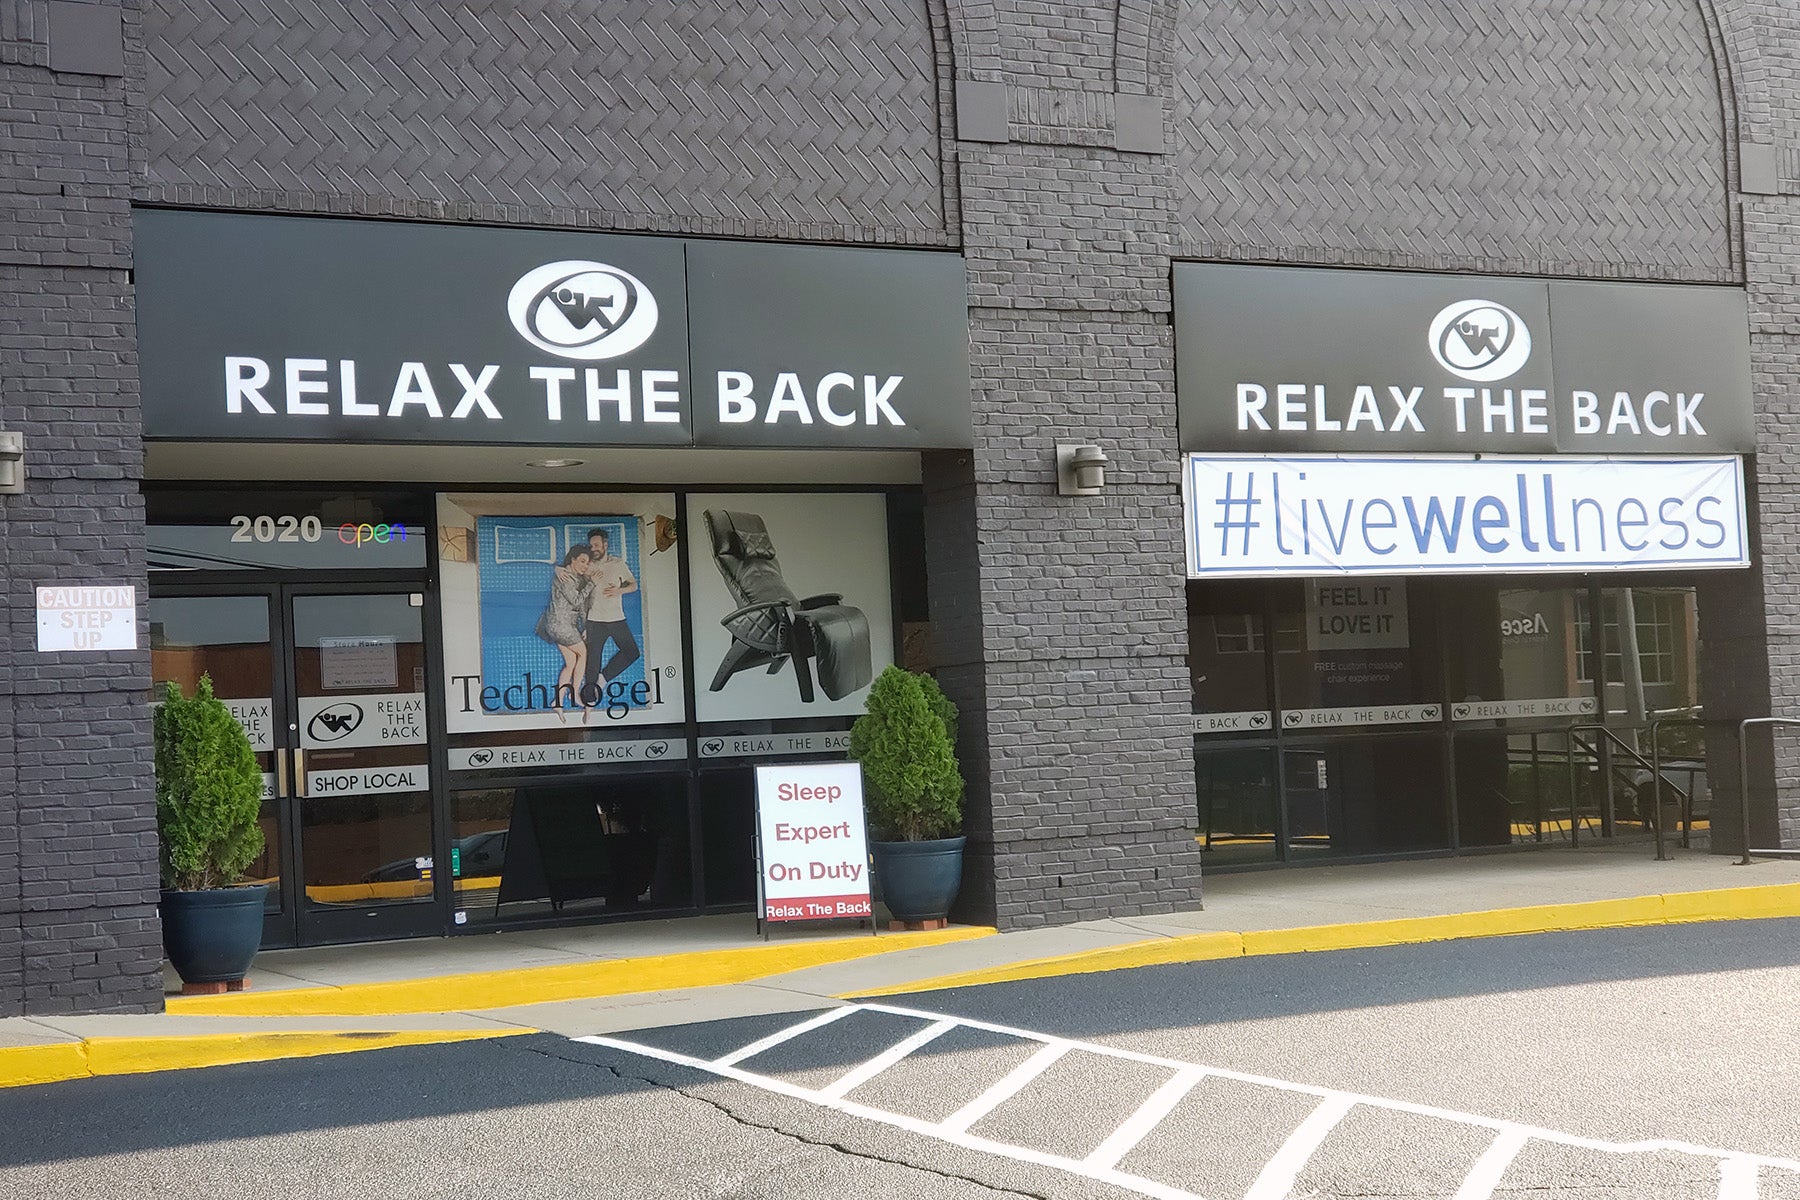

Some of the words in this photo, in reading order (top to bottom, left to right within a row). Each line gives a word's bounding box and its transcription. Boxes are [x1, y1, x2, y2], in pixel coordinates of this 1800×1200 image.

[224, 356, 503, 419] RELAX
[529, 366, 681, 423] THE
[716, 370, 906, 427] BACK
[1236, 383, 1426, 432] RELAX
[1443, 387, 1549, 434] THE
[1572, 390, 1708, 437] BACK
[1213, 470, 1727, 557] #livewellness
[230, 514, 322, 544] 2020
[338, 522, 407, 549] open
[40, 588, 131, 608] CAUTION
[1320, 587, 1368, 606] FEEL
[1374, 586, 1391, 605] IT
[60, 610, 113, 629] STEP
[1319, 615, 1372, 635] LOVE
[1376, 614, 1394, 633] IT
[72, 631, 103, 650] UP
[230, 706, 269, 718] ELAX
[377, 700, 422, 713] RELAX
[1477, 705, 1508, 716] RELAX
[1517, 704, 1535, 714] THE
[1545, 702, 1570, 713] BACK
[387, 713, 414, 725] THE
[1210, 718, 1239, 729] BACK
[1310, 712, 1343, 724] RELAX
[1354, 711, 1373, 721] THE
[1384, 710, 1411, 720] BACK
[381, 726, 420, 739] BACK
[734, 740, 774, 752] RELAX
[788, 738, 811, 749] THE
[825, 736, 849, 748] BAC
[502, 750, 545, 763] RELAX
[559, 748, 584, 761] THE
[597, 746, 633, 759] BACK
[315, 776, 358, 792] SHOP
[364, 772, 416, 789] LOCAL
[778, 783, 841, 803] Sleep
[775, 821, 851, 844] Expert
[769, 863, 801, 881] On
[809, 861, 862, 881] Duty
[766, 905, 803, 918] Relax
[807, 903, 833, 915] The
[836, 900, 872, 914] Back
